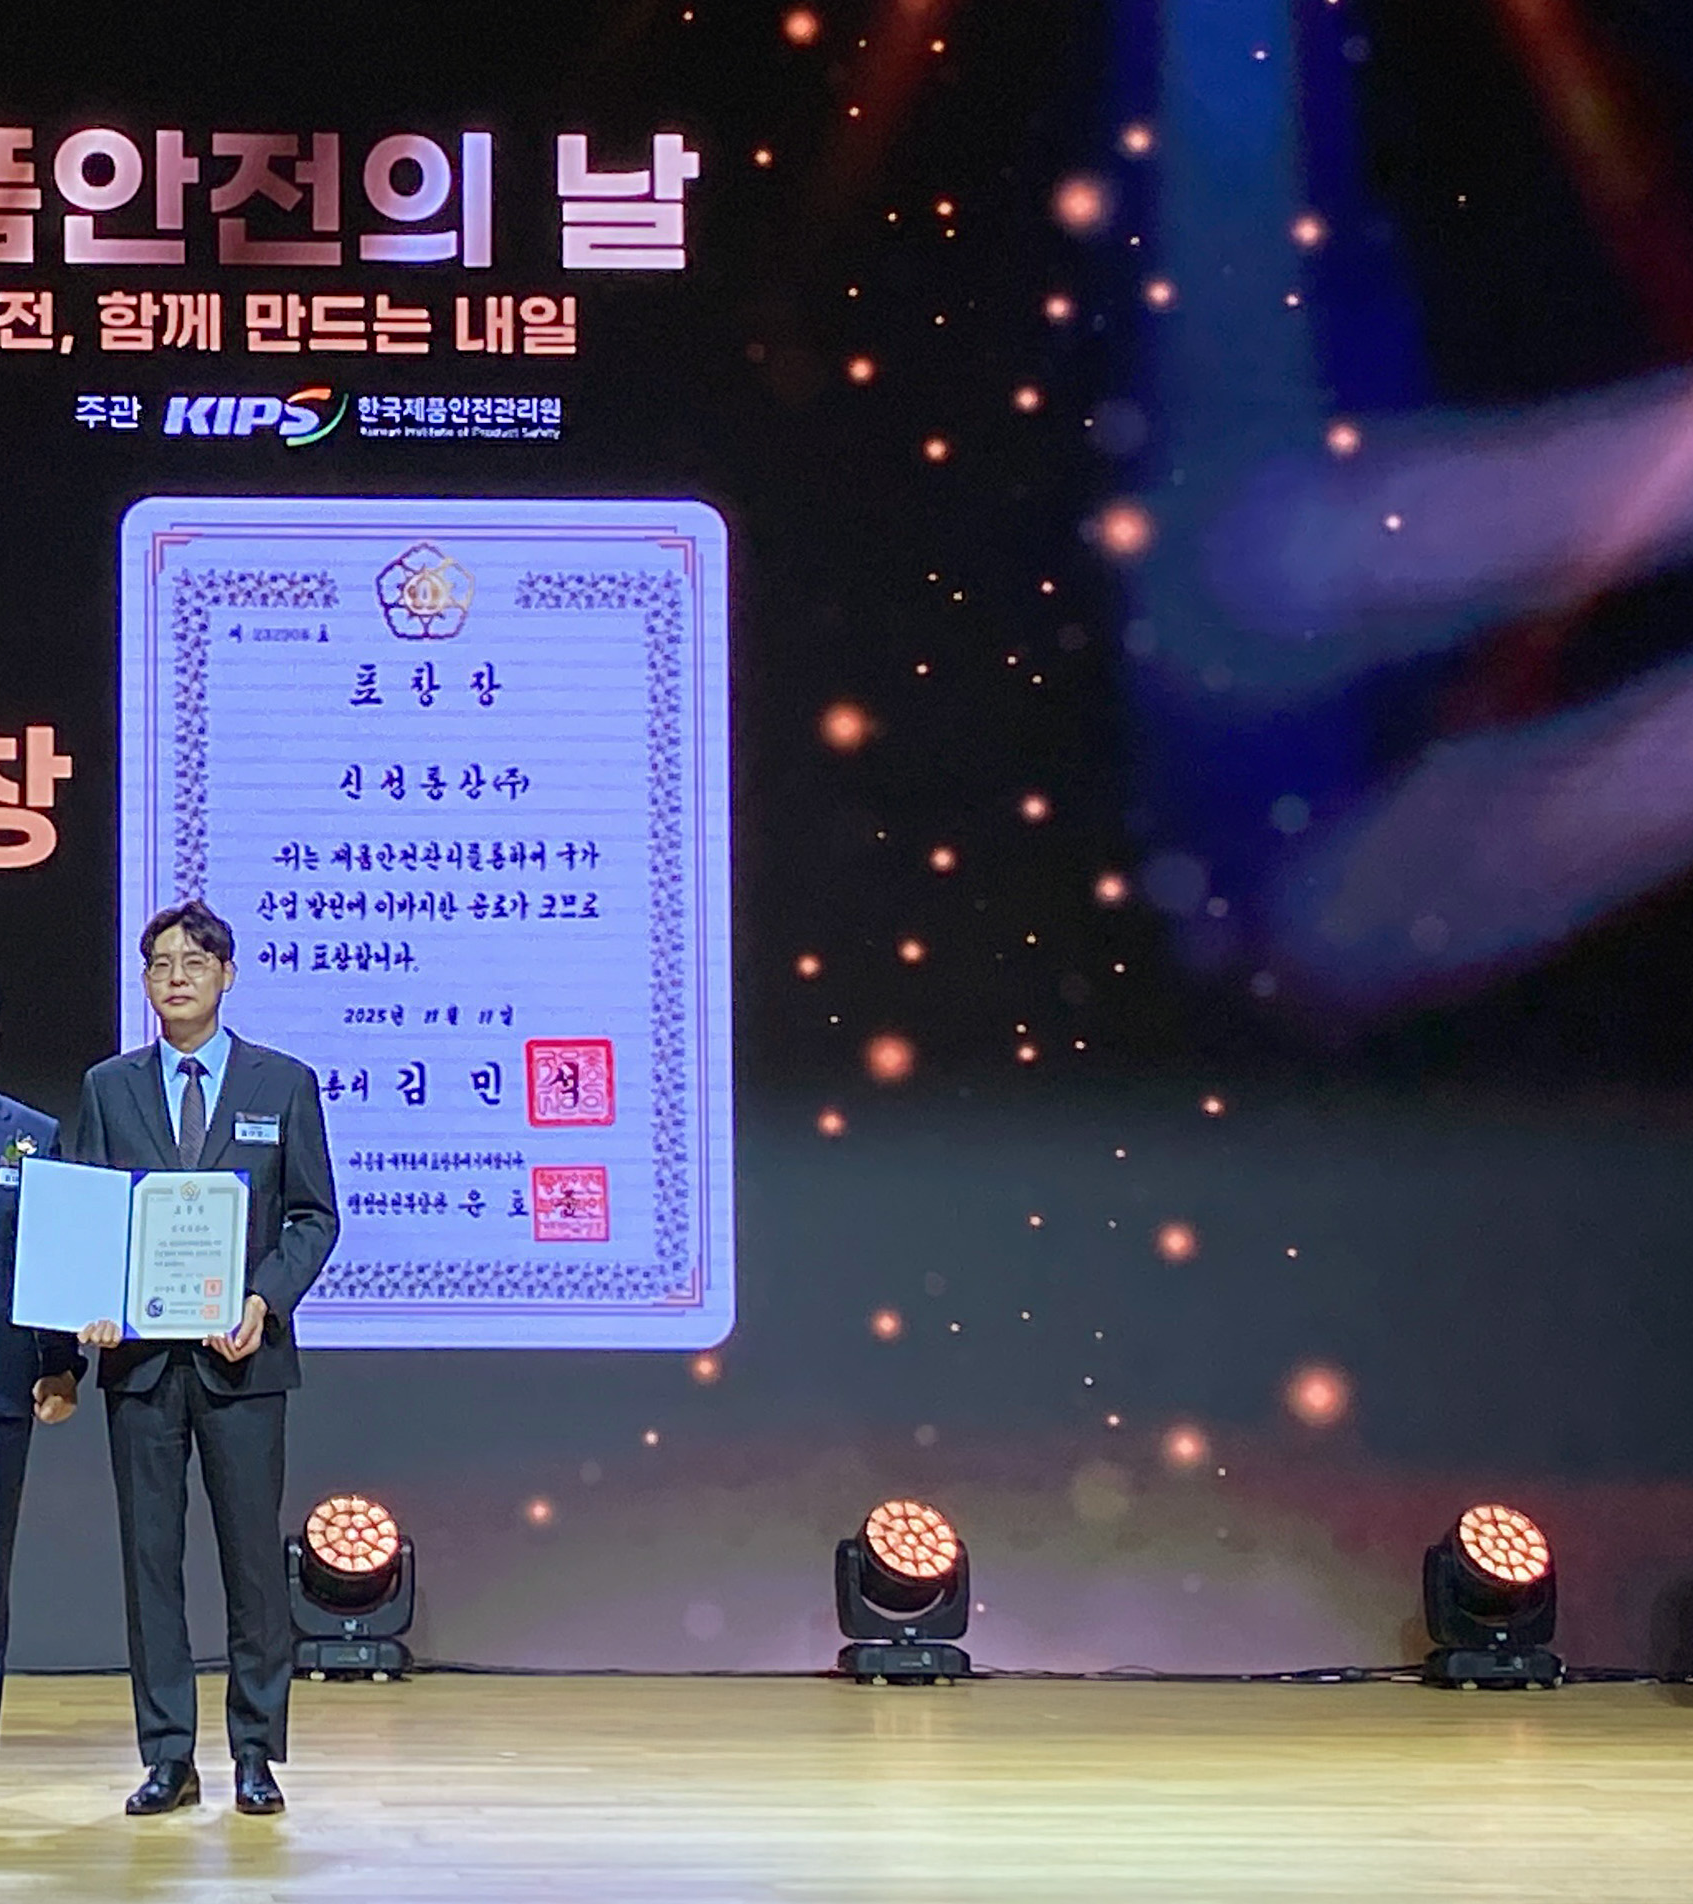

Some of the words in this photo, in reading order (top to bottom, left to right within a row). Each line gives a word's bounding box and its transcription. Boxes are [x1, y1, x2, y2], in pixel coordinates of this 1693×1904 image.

[556, 132, 700, 270] 날
[97, 290, 221, 352] 함께
[245, 293, 432, 355] 만드는
[454, 294, 578, 355] 내일
[74, 395, 143, 430] 주관
[163, 390, 323, 437] KIPS
[357, 395, 562, 424] 한국제품안전관리원
